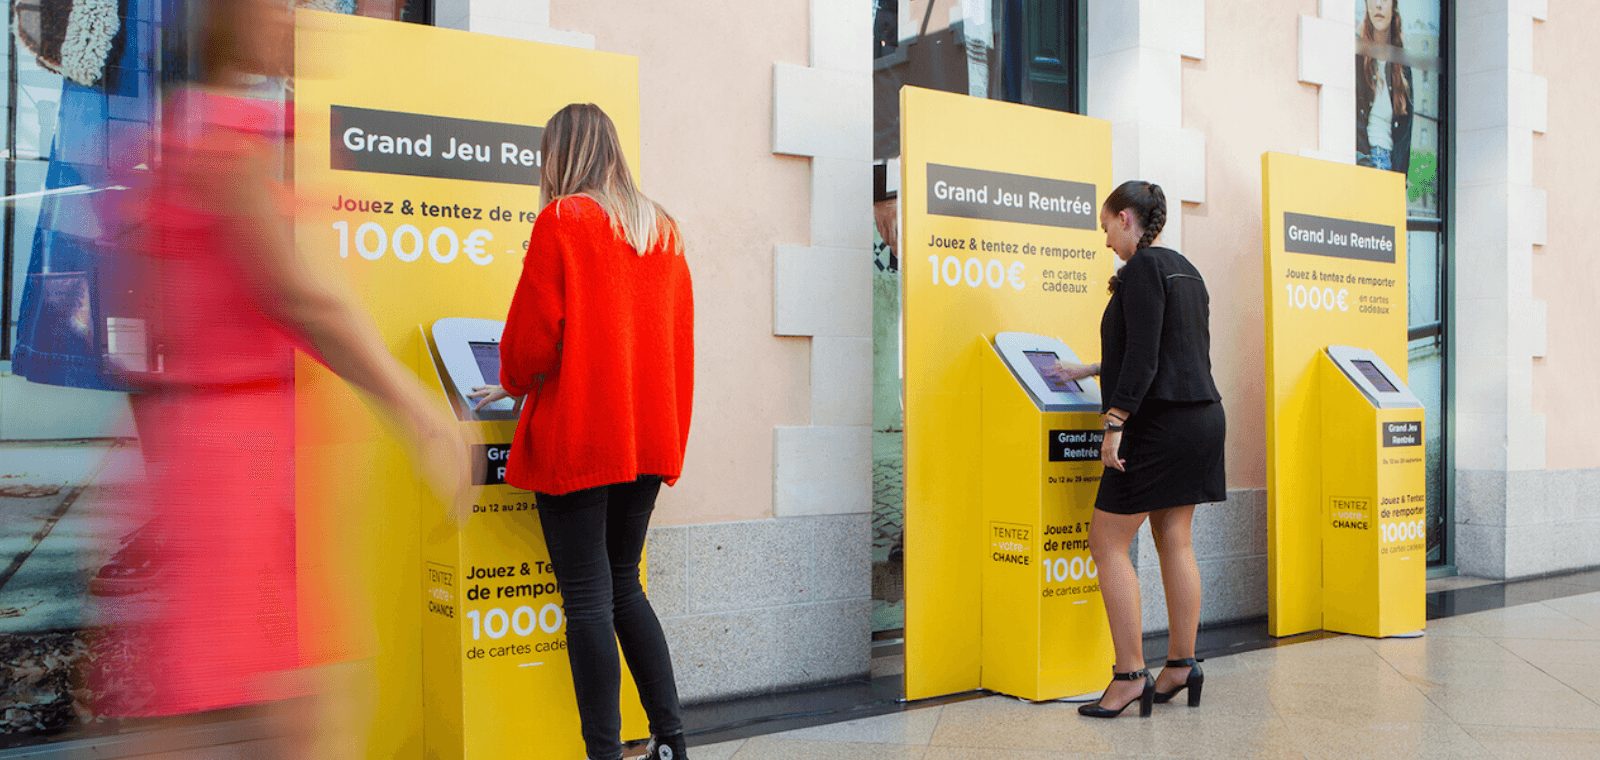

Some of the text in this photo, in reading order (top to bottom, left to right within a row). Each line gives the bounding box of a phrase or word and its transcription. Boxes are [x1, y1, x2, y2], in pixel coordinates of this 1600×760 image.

[343, 127, 432, 157] Grand
[441, 137, 491, 163] Jeu
[934, 180, 1092, 215] Grand Jeu Rentrée
[331, 195, 393, 214] Jouez
[400, 199, 414, 216] &
[421, 201, 482, 220] tentez
[489, 206, 512, 222] de
[331, 220, 494, 266] 1000€
[1288, 225, 1393, 252] Grand Jeu Rentrée
[928, 234, 1096, 260] Jouez & tentez de remporter
[928, 254, 1025, 291] 1000€
[1042, 268, 1087, 281] en cartes
[1285, 268, 1395, 287] Jouez & tentez de remporter
[1042, 281, 1088, 293] cadeaux
[1285, 283, 1349, 312] 1000€
[1359, 294, 1389, 304] en cartes
[1359, 304, 1390, 314] cadeaux
[1388, 423, 1407, 433] Grand
[1058, 432, 1103, 443] Grand Jeu
[1064, 447, 1099, 458] Rentrée
[1332, 499, 1368, 510] TENTEZ
[1381, 496, 1400, 505] Jouez
[473, 504, 486, 513] Du
[489, 503, 499, 512] 12
[502, 504, 514, 512] au
[516, 502, 528, 511] 29
[1380, 506, 1424, 518] de remporter
[1338, 511, 1362, 520] votre
[1044, 525, 1073, 535] Jouez
[1075, 522, 1082, 533] &
[1332, 520, 1368, 530] CHANCE
[1380, 519, 1425, 543] 1000€
[993, 526, 1029, 541] TENTEZ
[998, 540, 1024, 553] votre
[1043, 539, 1058, 552] de
[993, 552, 1029, 566] CHANCE
[466, 566, 515, 580] Jouez
[520, 562, 531, 576] &
[467, 584, 490, 600] de
[1042, 587, 1053, 598] de
[1056, 586, 1081, 596] cartes
[466, 603, 568, 641] 1000
[466, 647, 485, 659] de
[488, 644, 531, 658] cartes
